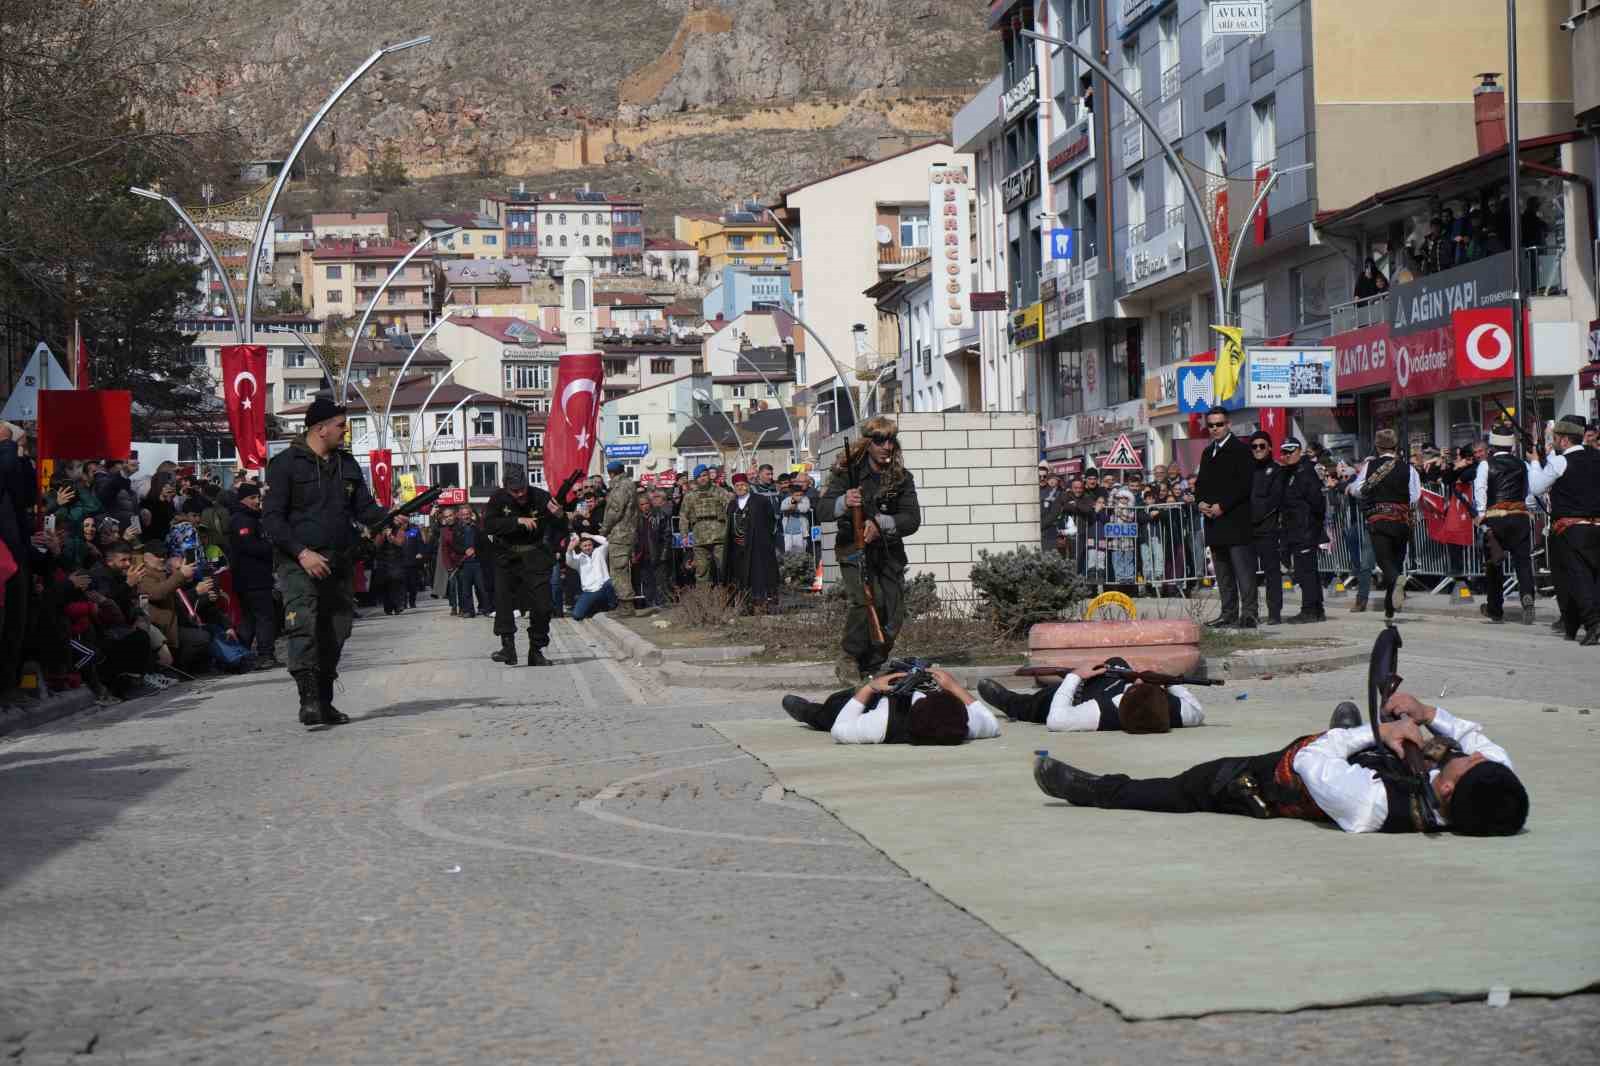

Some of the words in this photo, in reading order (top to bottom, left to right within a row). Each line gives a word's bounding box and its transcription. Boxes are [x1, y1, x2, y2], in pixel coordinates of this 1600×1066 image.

[1216, 7, 1257, 17] AVUKAT
[932, 170, 968, 185] OTEL
[1411, 287, 1443, 324] AĞIN
[1445, 279, 1478, 315] YAPI
[1371, 339, 1386, 369] 69
[1409, 347, 1448, 373] vodafone
